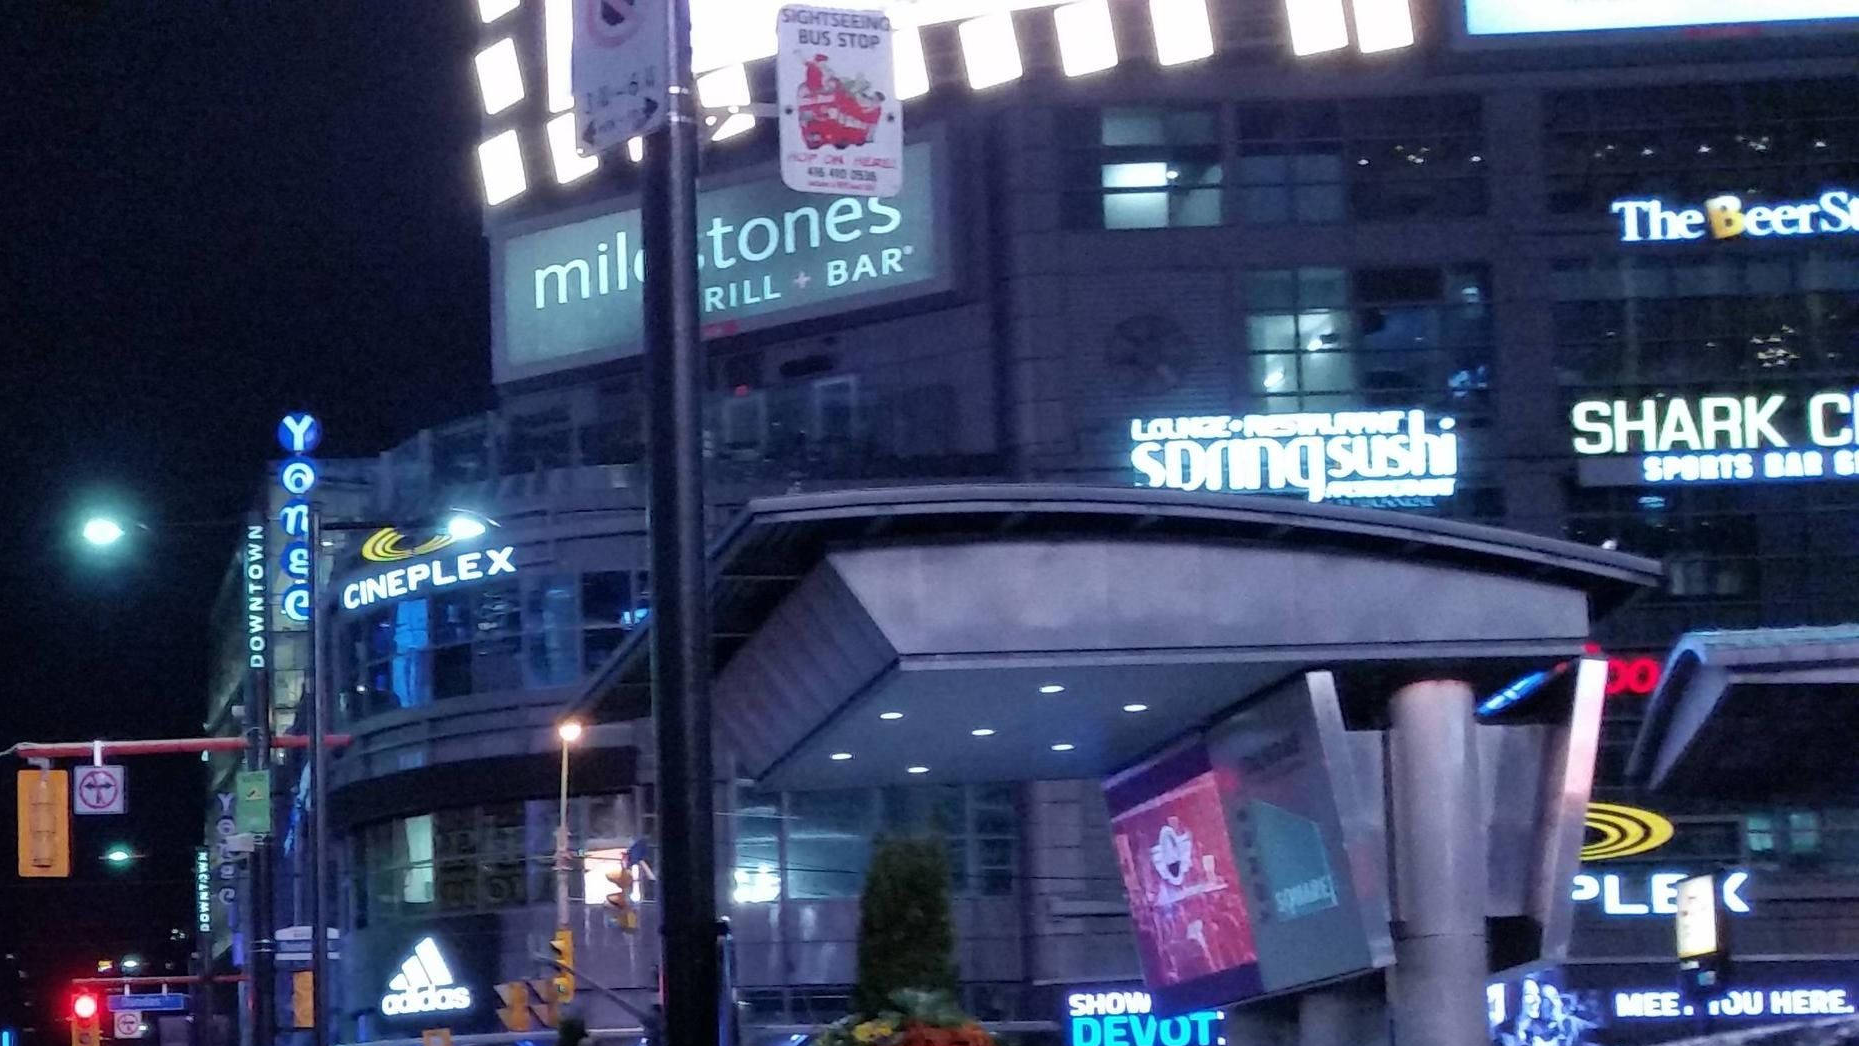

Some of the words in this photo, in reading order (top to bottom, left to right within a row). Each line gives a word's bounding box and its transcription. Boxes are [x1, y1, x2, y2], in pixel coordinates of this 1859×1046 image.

[782, 8, 890, 31] SIGHTSEEING
[798, 29, 831, 47] BUS
[838, 33, 880, 49] STOP
[1610, 199, 1706, 241] The
[1705, 195, 1820, 239] Beer
[534, 196, 903, 309] miltones
[704, 274, 782, 313] RILL
[1325, 409, 1458, 478] sushi
[1572, 394, 1790, 455] SHARK
[1643, 453, 1754, 482] SPORTS
[1764, 451, 1824, 478] BAR
[247, 524, 266, 668] DOWNTOWN
[343, 546, 517, 610] CINEPLEX
[382, 983, 470, 1016] adidas
[1068, 992, 1152, 1016] SHOW
[1615, 992, 1695, 1017] MEE
